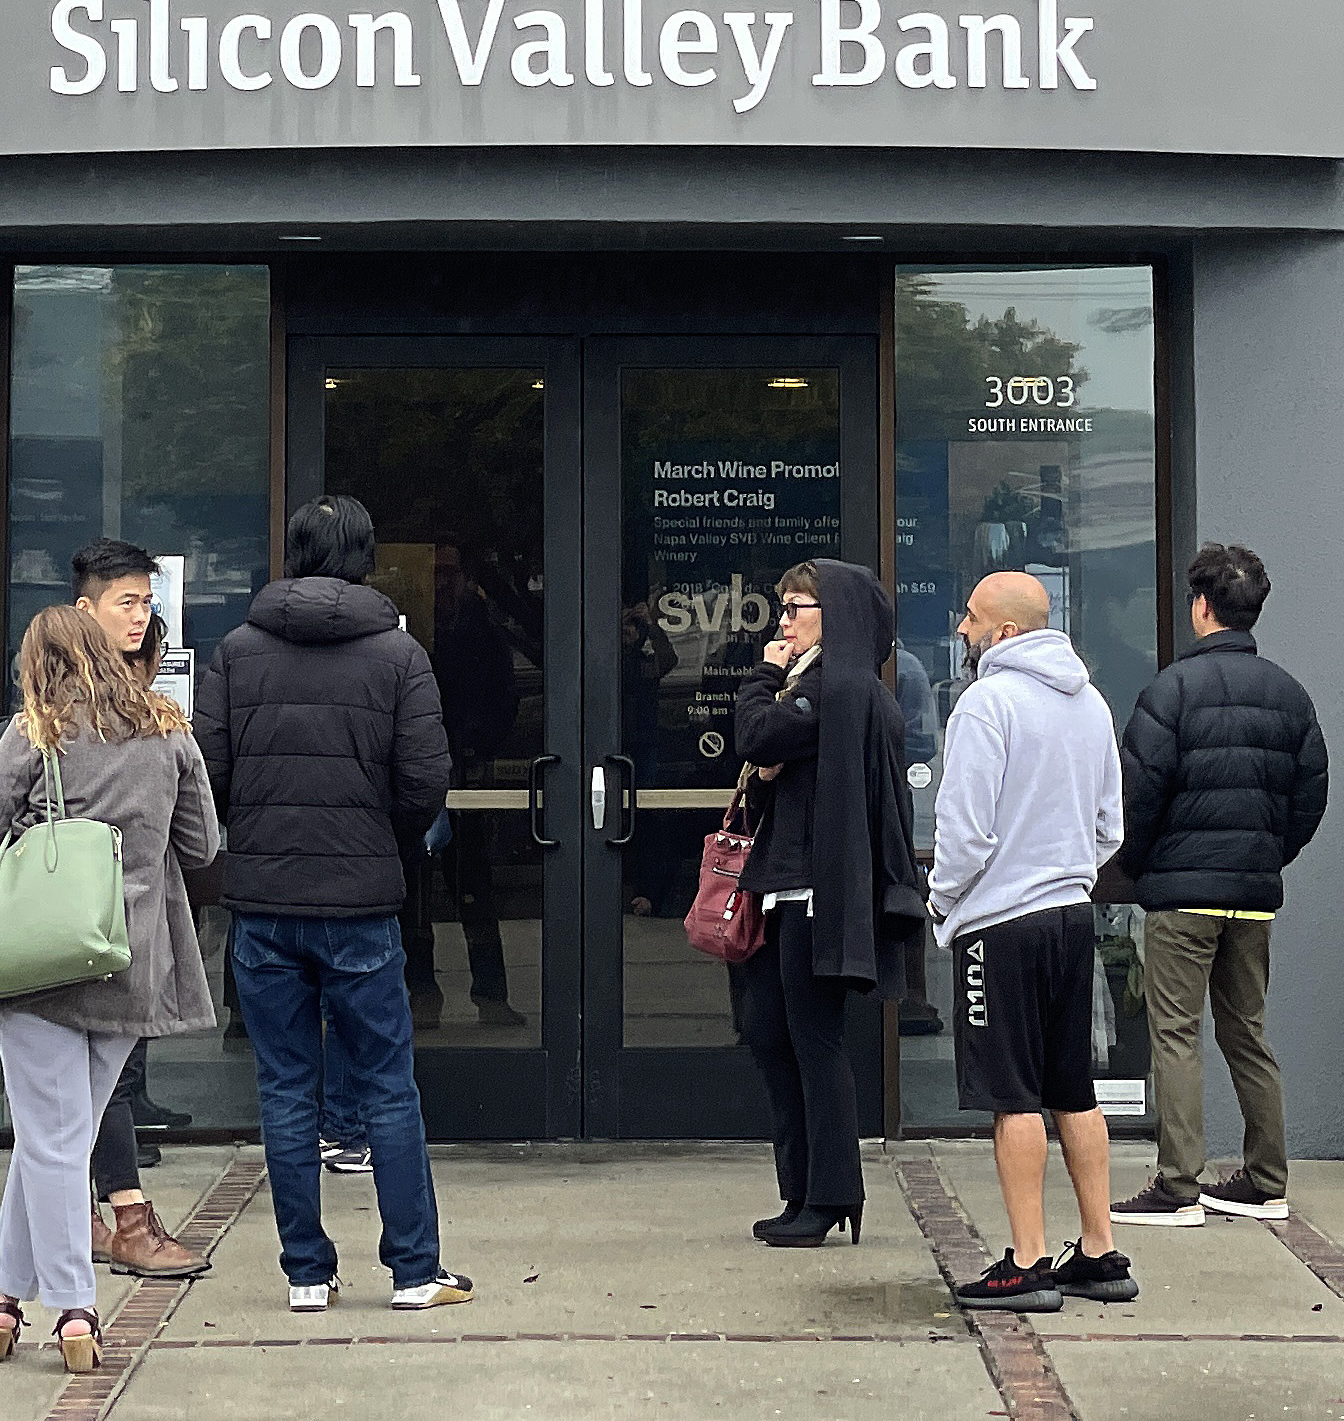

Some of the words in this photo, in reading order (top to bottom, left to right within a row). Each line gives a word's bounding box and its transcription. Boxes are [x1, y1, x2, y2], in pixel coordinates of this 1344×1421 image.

[985, 376, 1075, 408] 3003
[968, 418, 1016, 432] SOUTH
[1020, 418, 1093, 432] ENTRANCE
[654, 461, 715, 479] March
[717, 461, 767, 479] Wine
[654, 489, 720, 507] Robert
[723, 489, 775, 510] Craig
[654, 516, 700, 529] Special
[703, 516, 743, 528] friends
[749, 516, 771, 527] and
[774, 516, 810, 529] family
[654, 533, 686, 546] Napa
[689, 533, 727, 546] Valley
[729, 532, 757, 545] SVB
[761, 533, 792, 544] Wine
[794, 532, 830, 544] Client
[655, 550, 698, 563] Winery
[657, 573, 771, 633] svb
[703, 666, 729, 676] Main
[695, 692, 731, 701] Branch
[687, 706, 710, 715] 9:00
